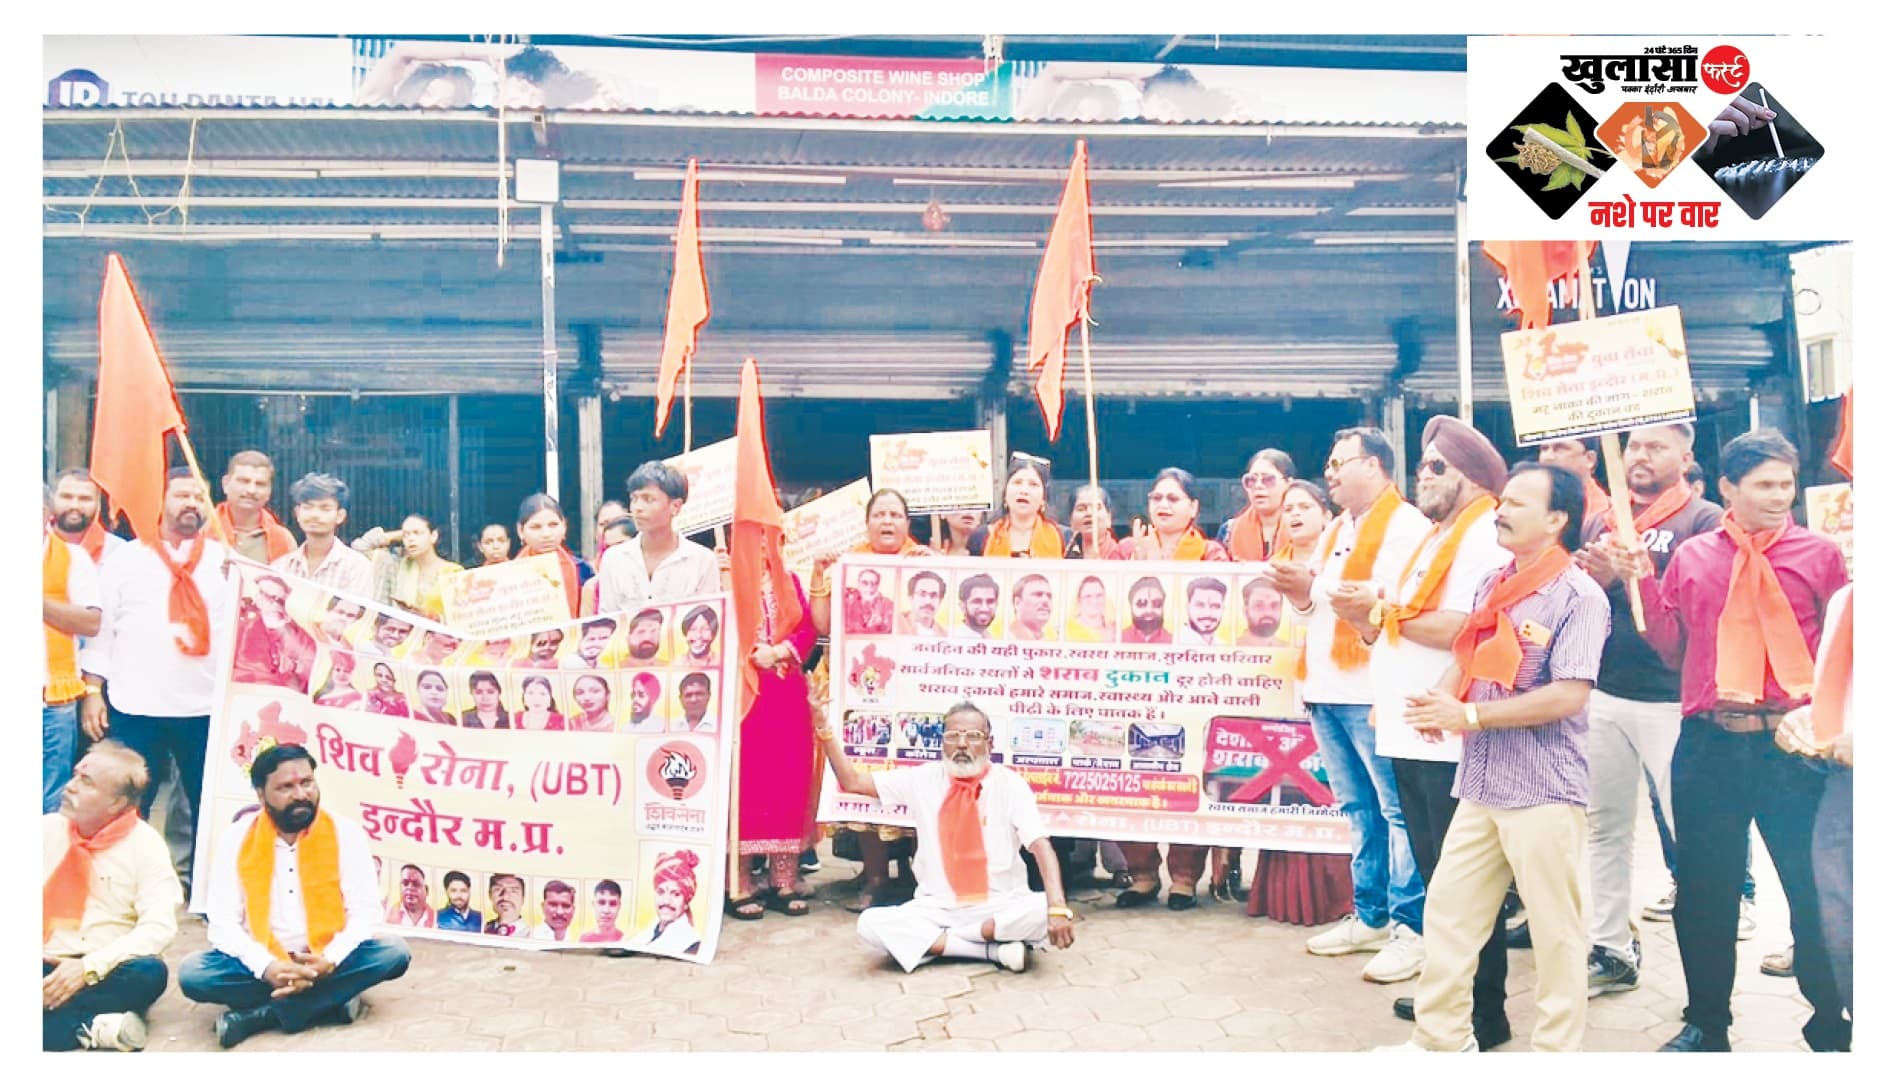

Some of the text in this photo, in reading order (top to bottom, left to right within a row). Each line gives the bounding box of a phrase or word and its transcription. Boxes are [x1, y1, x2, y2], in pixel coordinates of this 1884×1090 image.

[781, 67, 986, 87] COMPOSITE WINE SHOP
[777, 85, 838, 102] BALDA
[923, 90, 989, 107] INDORE
[913, 641, 963, 655] जनहित
[967, 643, 987, 655] की
[991, 644, 1018, 657] यही
[1220, 650, 1272, 664] परिवार
[1023, 667, 1035, 680] से
[1040, 667, 1099, 682] शराब
[1105, 669, 1170, 688] दुकान
[1176, 674, 1194, 691] दूर
[1237, 673, 1283, 690] चाहिए
[918, 683, 959, 694] शराब
[1008, 686, 1045, 699] हमारे
[1157, 690, 1184, 704] और
[1188, 691, 1218, 706] आने
[1223, 693, 1261, 707] वाली
[1046, 703, 1062, 717] के
[1065, 703, 1094, 719] लिए
[316, 722, 622, 805] शिव सेना, (UBT)
[1063, 771, 1141, 793] 7225025125
[360, 798, 463, 847] इन्दौर
